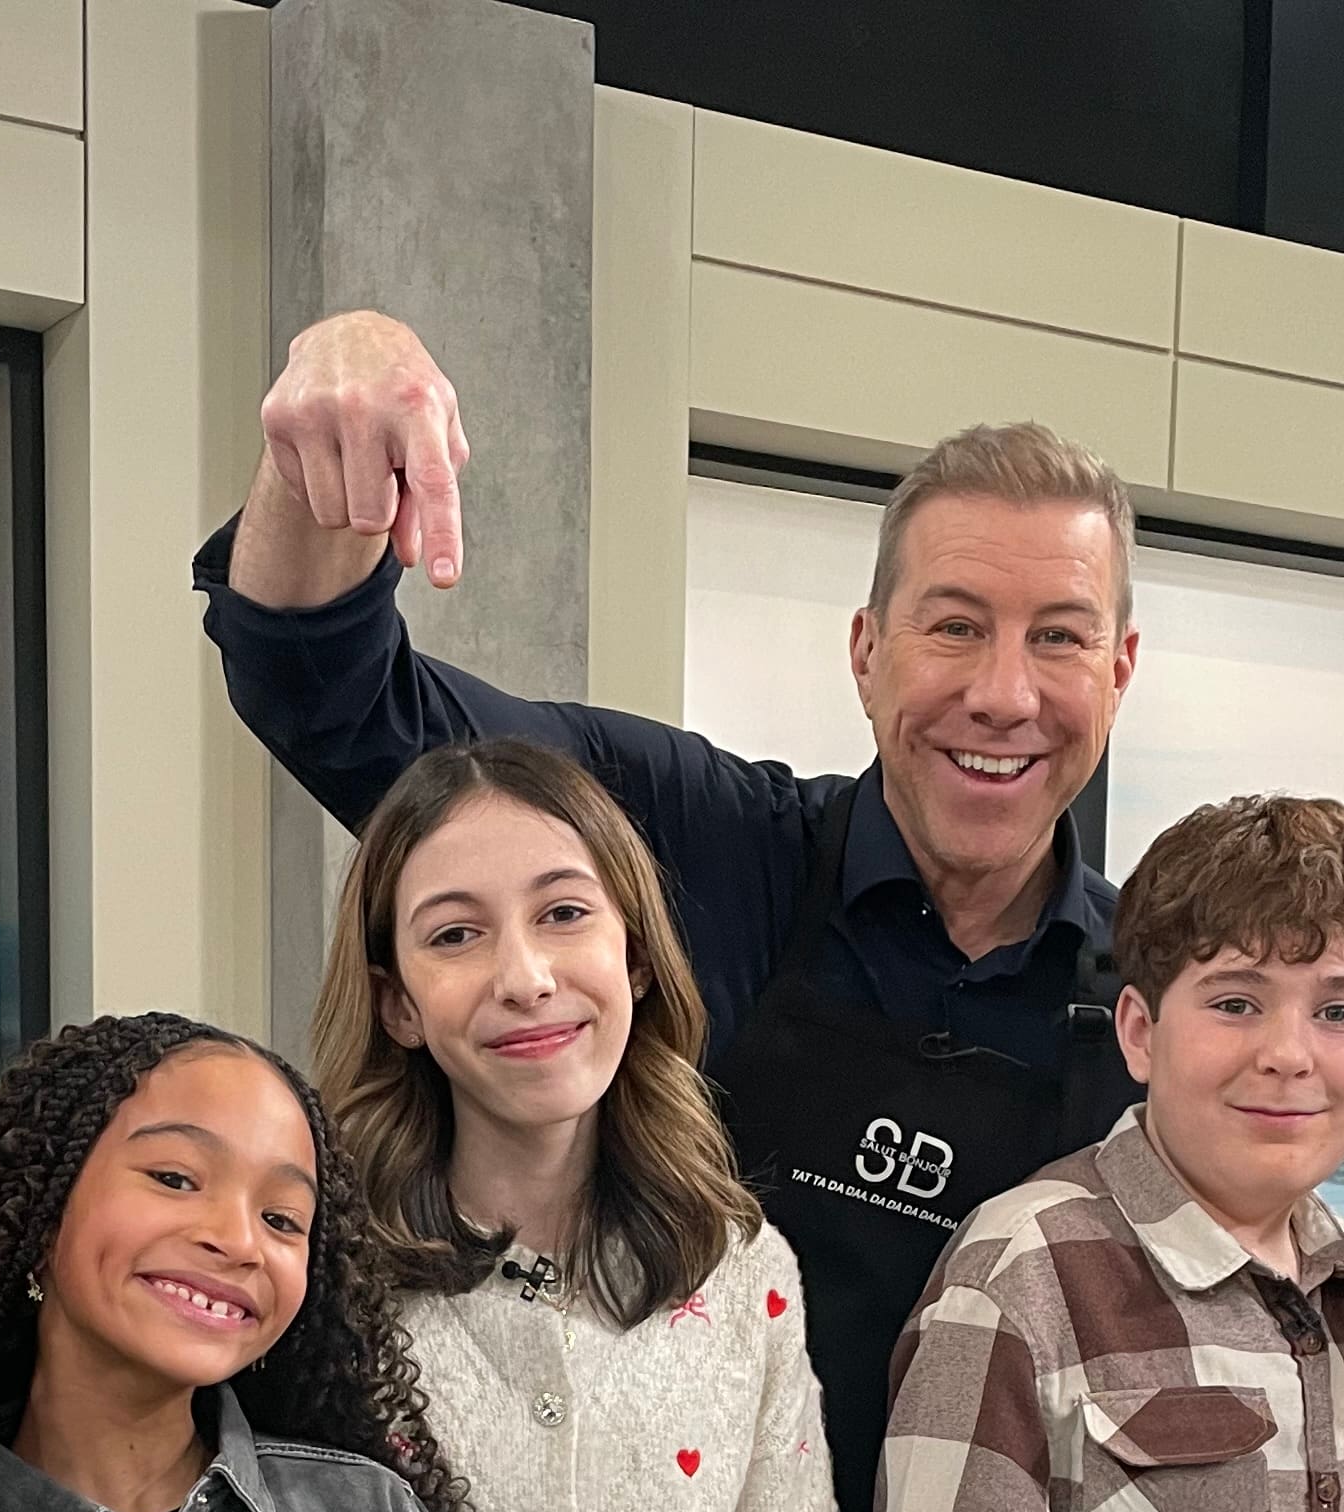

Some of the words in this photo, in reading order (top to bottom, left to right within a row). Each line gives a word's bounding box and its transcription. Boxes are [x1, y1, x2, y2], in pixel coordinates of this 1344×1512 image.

[859, 1137, 897, 1158] SALUT
[899, 1151, 952, 1178] BONJOUR
[792, 1169, 813, 1183] TAT
[813, 1175, 827, 1188] TA
[827, 1180, 844, 1194] DA
[869, 1194, 887, 1207] DA
[886, 1200, 903, 1212] DA
[902, 1205, 919, 1217] DA
[918, 1210, 942, 1225] DAA
